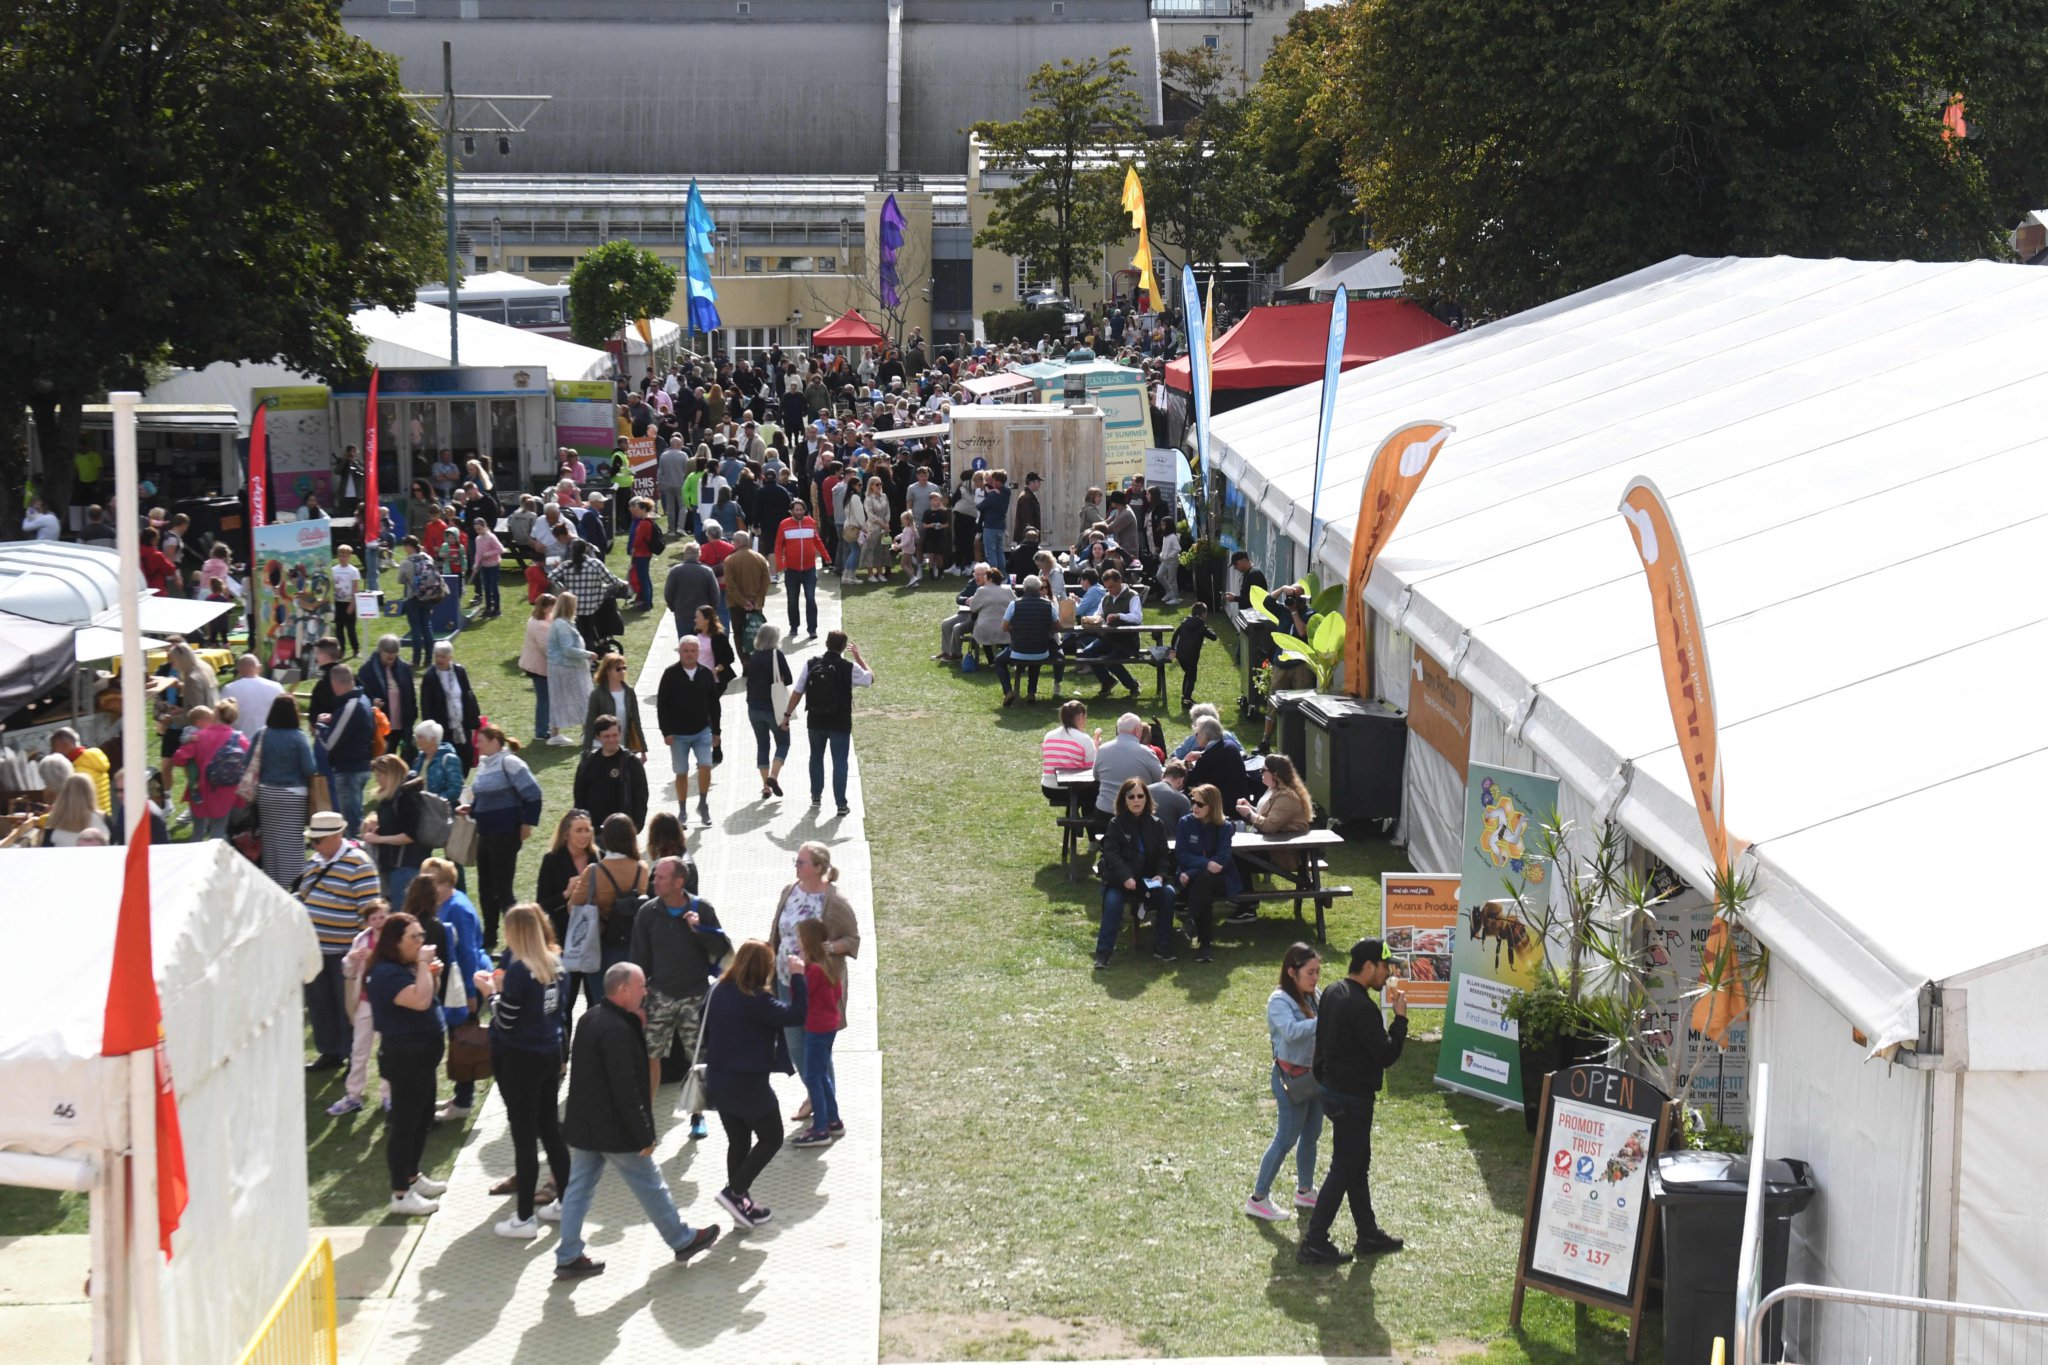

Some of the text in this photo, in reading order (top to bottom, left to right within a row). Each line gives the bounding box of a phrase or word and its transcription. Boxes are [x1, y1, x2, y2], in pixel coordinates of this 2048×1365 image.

[1115, 429, 1148, 438] SUMMER
[628, 448, 655, 458] STALLS
[634, 478, 654, 488] THIS
[634, 488, 655, 498] WAY
[1671, 559, 1685, 600] food
[391, 604, 398, 614] 2
[1393, 902, 1458, 911] Manx Produc
[1466, 979, 1480, 988] ELLAN
[1480, 983, 1496, 992] VANNIN
[1466, 1011, 1480, 1022] Find
[1490, 1020, 1498, 1028] on
[1570, 1069, 1634, 1110] OPEN
[1692, 1075, 1744, 1090] COMETIT
[54, 1103, 76, 1119] 46
[1558, 1112, 1605, 1137] PROMOTE
[1572, 1136, 1604, 1157] TRUST
[1562, 1242, 1610, 1266] 75 137
